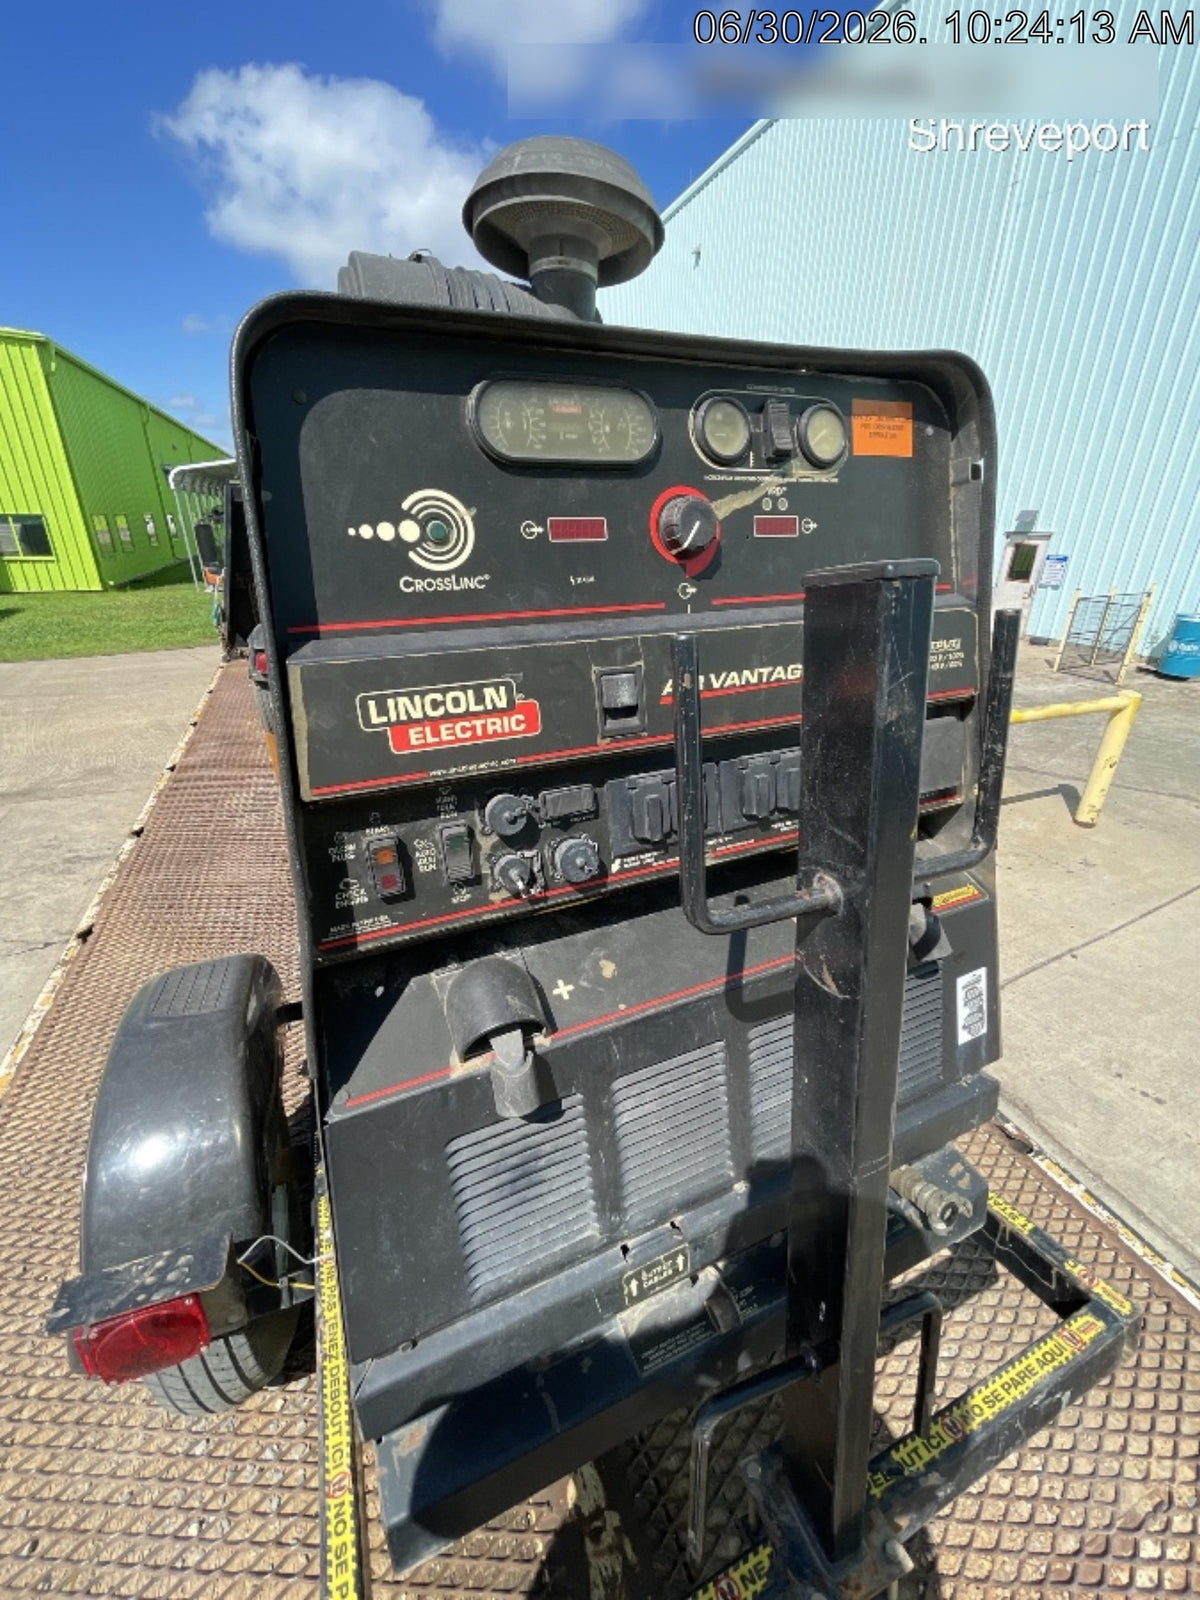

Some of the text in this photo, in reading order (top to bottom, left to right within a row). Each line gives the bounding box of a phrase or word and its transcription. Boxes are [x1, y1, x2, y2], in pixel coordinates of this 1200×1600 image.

[709, 663, 804, 689] VANTAG
[366, 685, 508, 725] LINCOLN
[408, 713, 527, 746] ELECTRIC
[329, 1365, 343, 1437] DEBOUT
[980, 1387, 1005, 1409] SE
[1000, 1363, 1039, 1396] PARE
[332, 1441, 344, 1471] ICI
[921, 1430, 947, 1454] ICI
[333, 1500, 347, 1537] NO
[335, 1541, 348, 1579] SE
